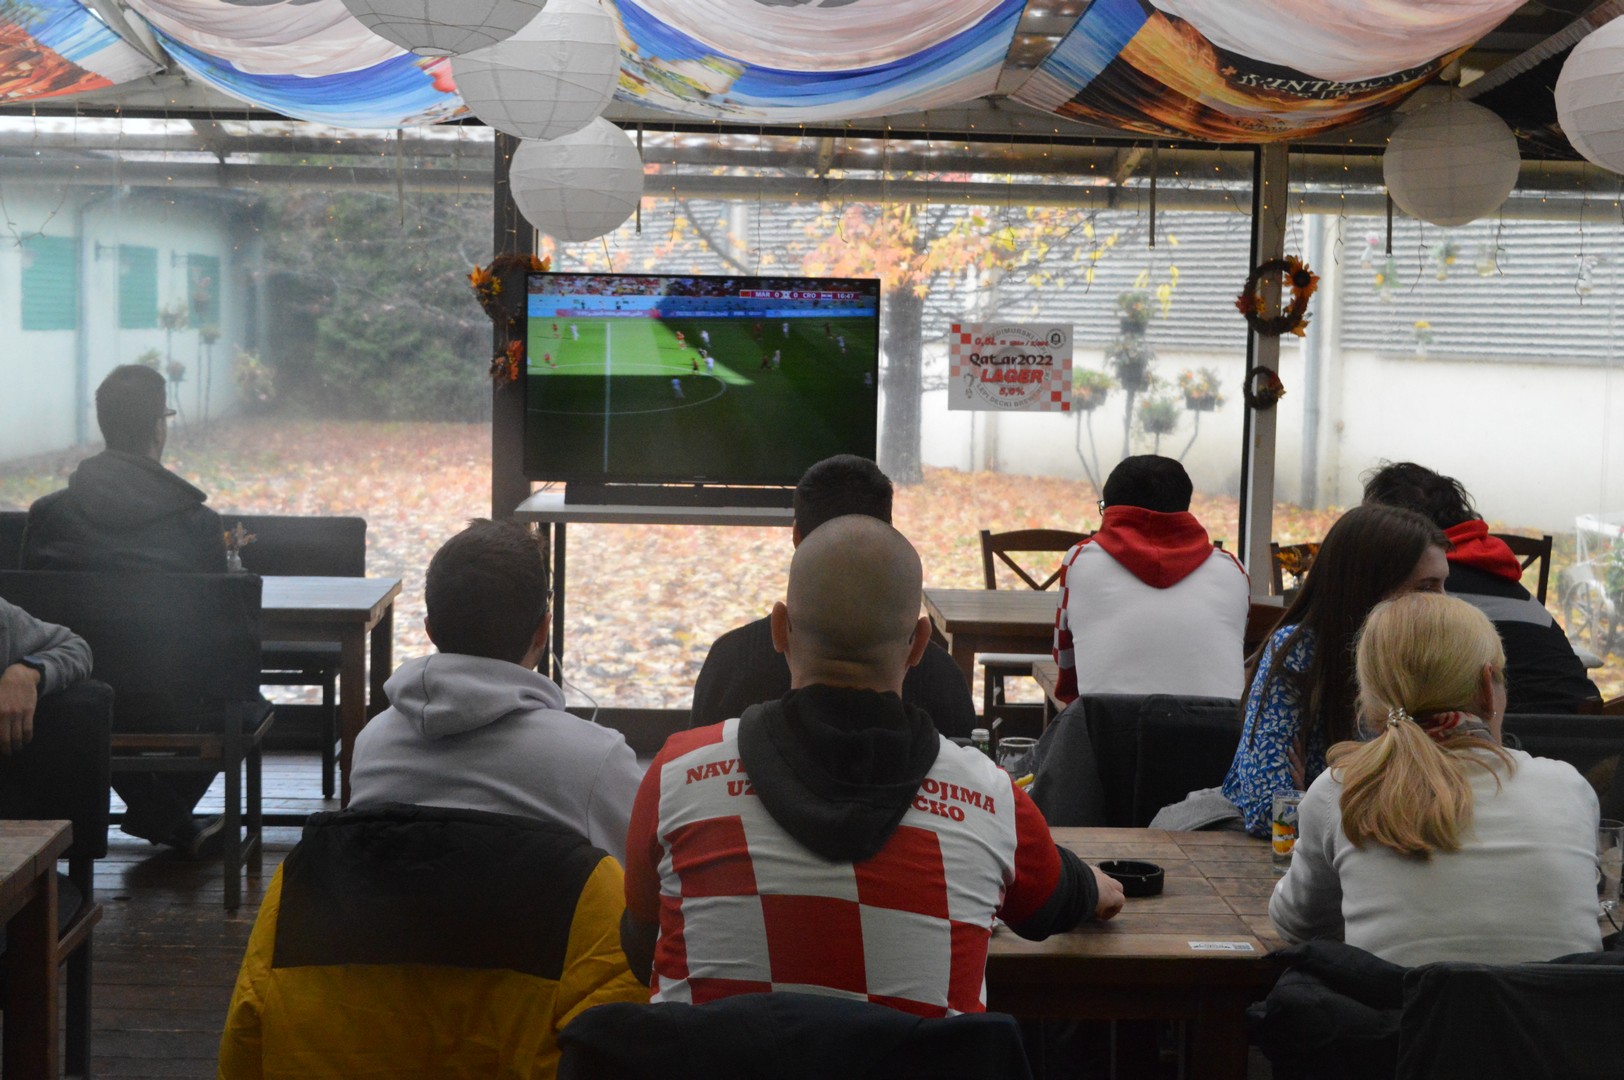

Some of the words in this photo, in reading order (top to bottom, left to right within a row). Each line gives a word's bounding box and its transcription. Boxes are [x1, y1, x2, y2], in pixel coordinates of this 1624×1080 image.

[969, 353, 1053, 367] Qatar2022
[980, 369, 1044, 384] LAGER
[921, 778, 996, 815] OJIMA
[911, 795, 965, 822] ČKO
